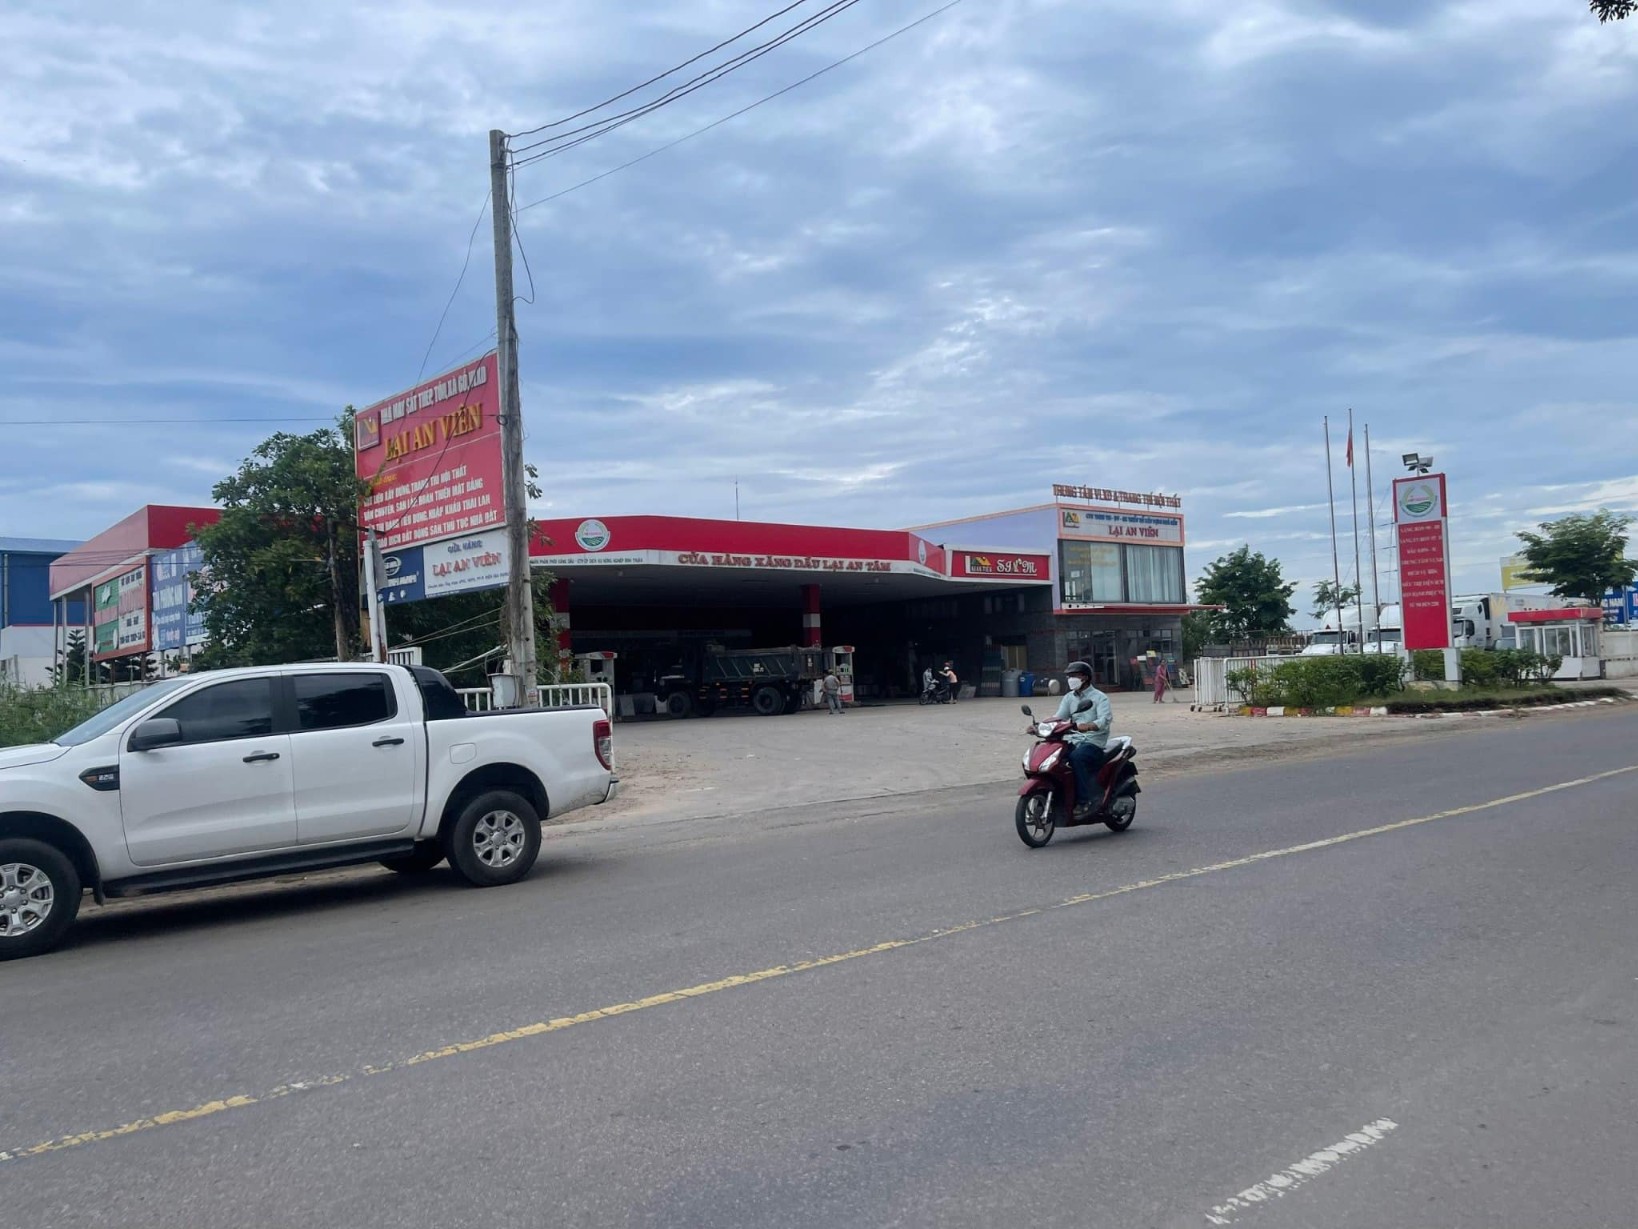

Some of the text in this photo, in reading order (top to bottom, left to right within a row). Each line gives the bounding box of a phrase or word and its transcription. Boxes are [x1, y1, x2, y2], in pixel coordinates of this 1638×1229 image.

[385, 401, 484, 464] LẠI AN VIÊN
[1109, 525, 1159, 538] LẠI AN VIÊN
[453, 558, 471, 574] AN
[678, 551, 892, 573] CỬA HÀNG XĂNG DẦU LẠI AN TÂM
